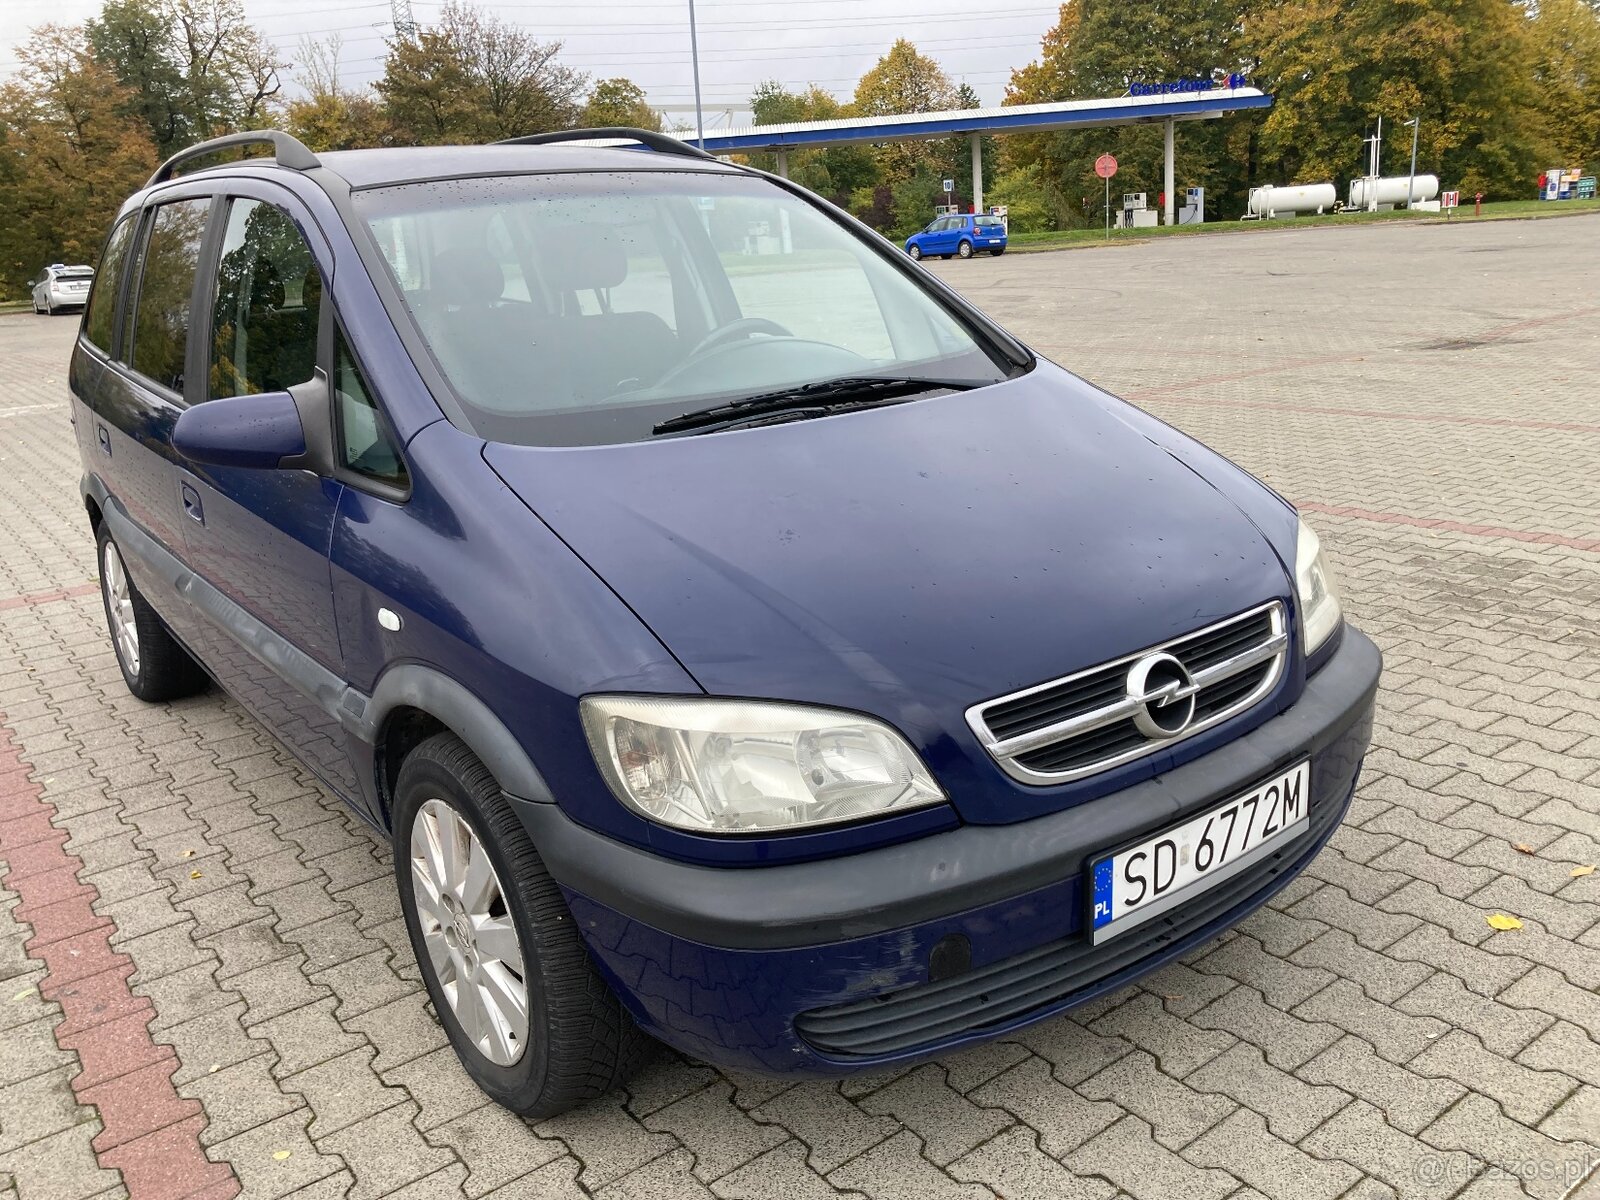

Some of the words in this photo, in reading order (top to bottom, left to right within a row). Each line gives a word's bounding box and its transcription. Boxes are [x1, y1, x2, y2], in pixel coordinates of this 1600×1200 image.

[1130, 79, 1214, 96] Carrefour
[1123, 839, 1177, 907] SD
[1194, 769, 1302, 872] 6772M
[1094, 902, 1110, 920] PL
